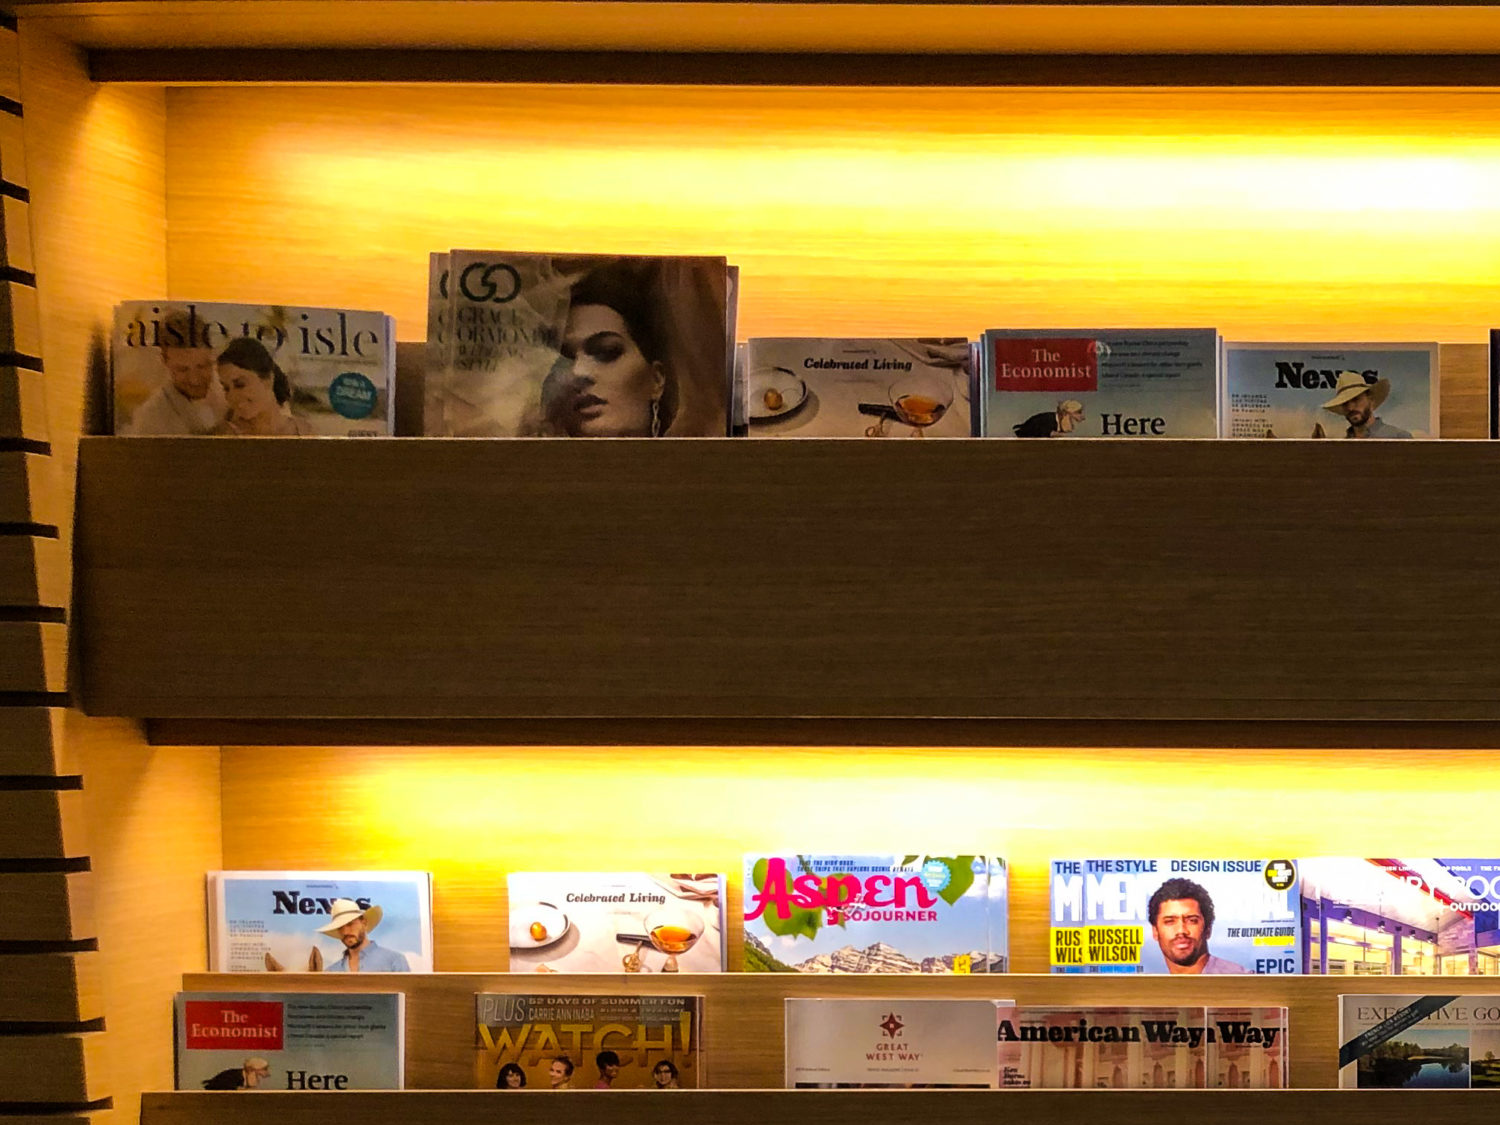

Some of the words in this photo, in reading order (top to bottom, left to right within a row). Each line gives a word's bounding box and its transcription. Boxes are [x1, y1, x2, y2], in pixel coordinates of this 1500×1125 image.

[127, 305, 227, 348] aisle
[299, 312, 378, 356] isle
[1031, 349, 1061, 362] The
[803, 358, 869, 370] Celebrated
[873, 358, 912, 371] Living
[1001, 363, 1092, 378] Economist
[1274, 361, 1379, 389] Nexs
[1101, 413, 1166, 435] Here
[1088, 860, 1113, 872] THE
[1115, 860, 1157, 872] STYLE
[1171, 860, 1220, 872] DESIGN
[1222, 860, 1262, 872] ISSUE
[566, 892, 626, 904] Celebrated
[629, 892, 666, 905] Living
[744, 857, 937, 926] Aspen
[272, 890, 372, 915] Nexs
[843, 910, 938, 922] SOJOURNER
[1088, 928, 1142, 945] RUSSELL
[1088, 945, 1137, 962] WILSON
[1256, 958, 1295, 974] EPIC
[220, 1009, 249, 1023] The
[483, 997, 526, 1022] PLUS
[191, 1023, 278, 1038] Economist
[997, 1018, 1141, 1043] American
[1141, 1020, 1206, 1048] Way
[1216, 1020, 1281, 1048] Way
[478, 1012, 692, 1068] WATCH!
[876, 1043, 909, 1051] GREAT
[866, 1053, 894, 1061] WEST
[898, 1053, 921, 1061] WAY
[286, 1070, 349, 1089] Here
